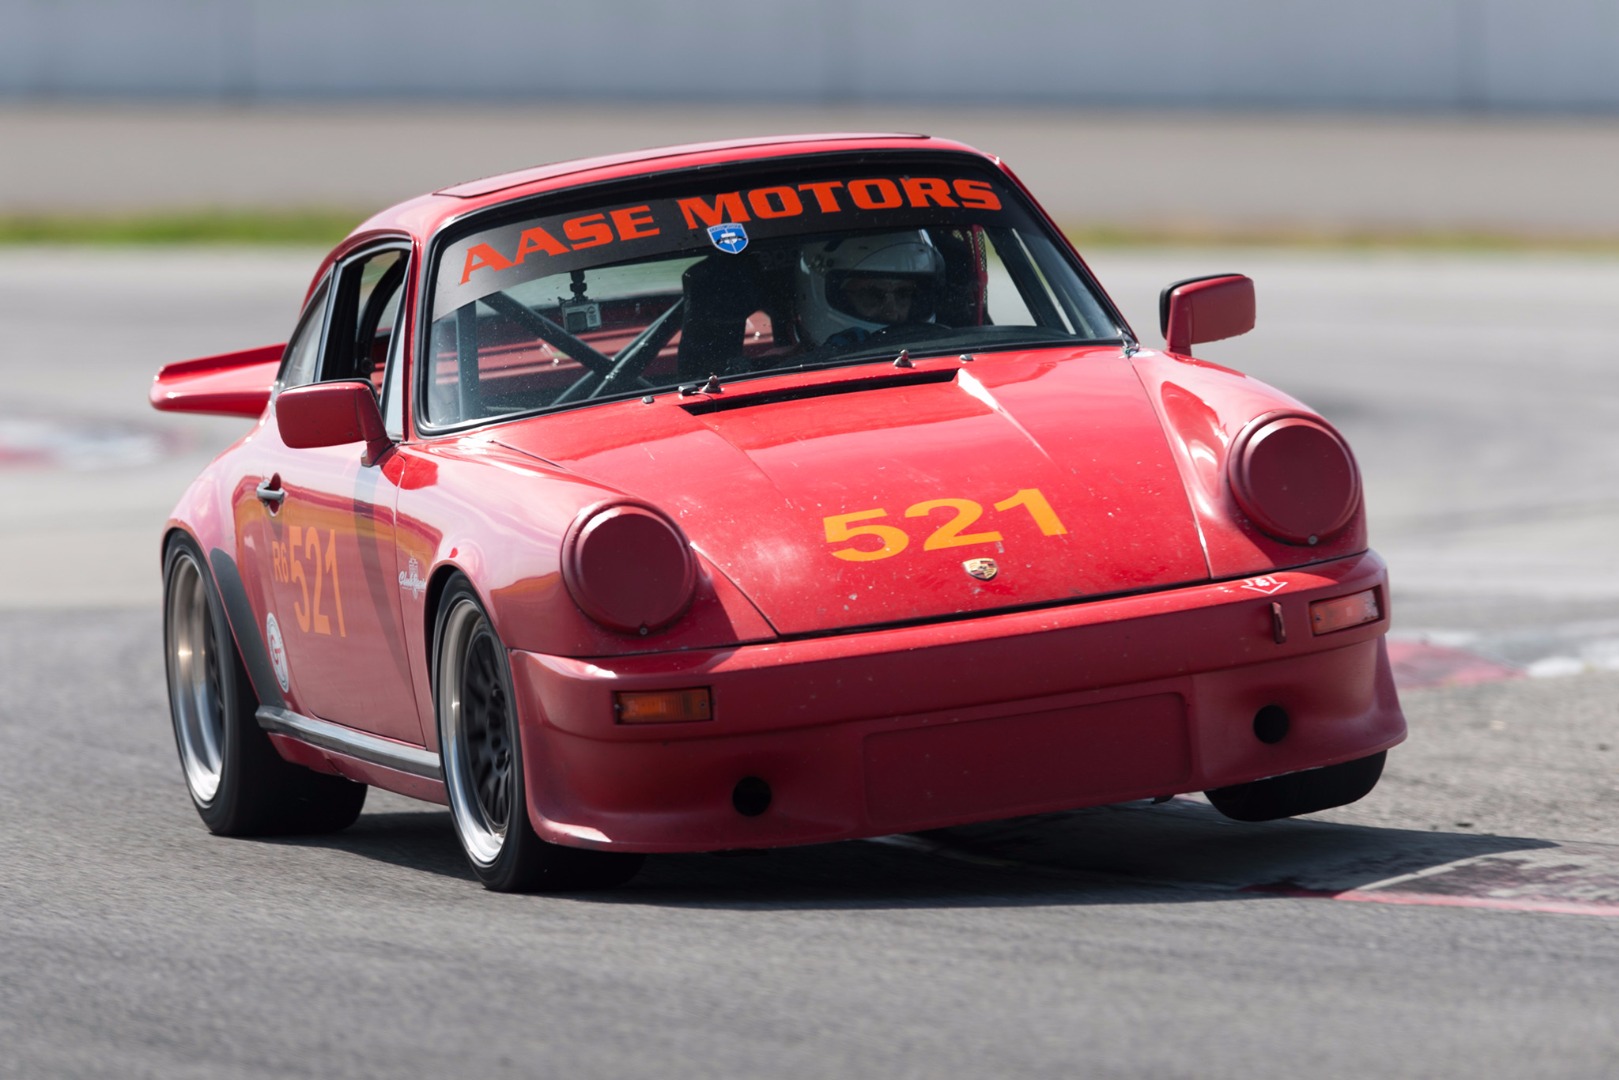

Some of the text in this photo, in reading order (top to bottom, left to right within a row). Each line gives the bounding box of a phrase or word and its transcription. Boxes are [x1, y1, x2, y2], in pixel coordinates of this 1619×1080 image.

[459, 177, 1002, 285] AASE MOTORS
[823, 488, 1068, 562] 521
[272, 525, 346, 638] R6 521
